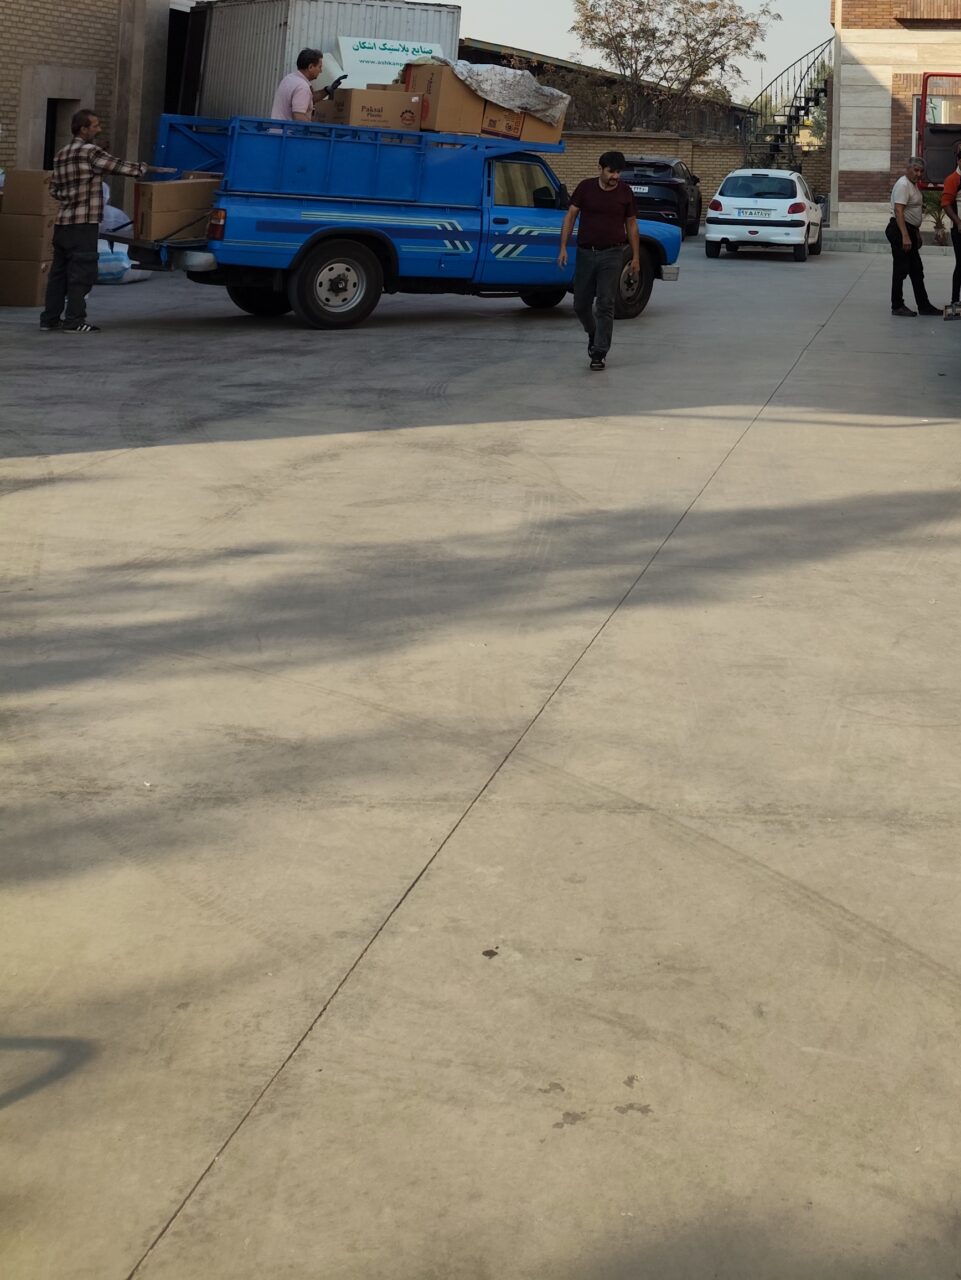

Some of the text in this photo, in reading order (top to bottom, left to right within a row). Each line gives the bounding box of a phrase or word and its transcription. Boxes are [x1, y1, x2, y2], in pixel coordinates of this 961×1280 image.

[352, 40, 433, 56] صنایع پلاستیک اشکان
[361, 105, 384, 113] Paksal
